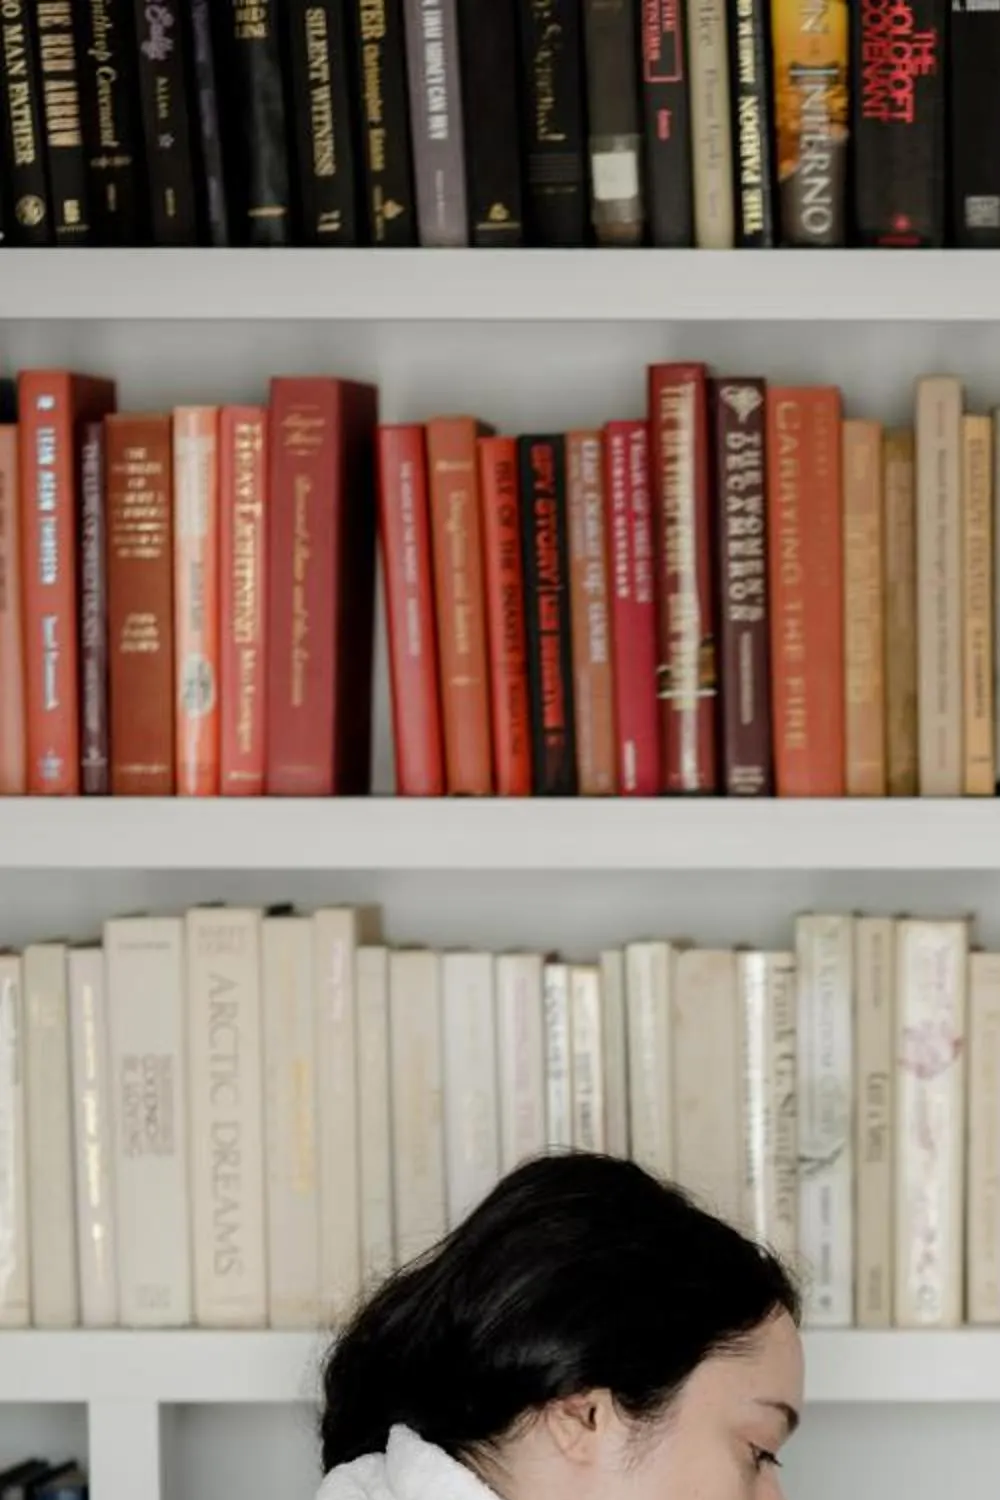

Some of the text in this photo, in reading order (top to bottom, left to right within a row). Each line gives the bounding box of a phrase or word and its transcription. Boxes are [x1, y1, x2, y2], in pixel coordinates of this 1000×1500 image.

[4, 23, 28, 76] MAN
[36, 1, 83, 148] HE RED ARROW
[304, 8, 337, 177] SILENT WITNESS
[914, 28, 938, 77] THE
[8, 81, 35, 165] FATHER
[739, 95, 763, 184] PARDON
[742, 188, 764, 235] THE
[530, 444, 555, 491] SPY
[745, 431, 763, 487] THE
[534, 498, 561, 584] STORY
[726, 431, 746, 623] DECAMERON
[744, 495, 763, 623] WOMEN'S
[776, 401, 808, 751] CARRYING THE FIRE
[206, 970, 245, 1278] ARCTIC DREAMS
[773, 965, 800, 1223] Frank G. Slaughter
